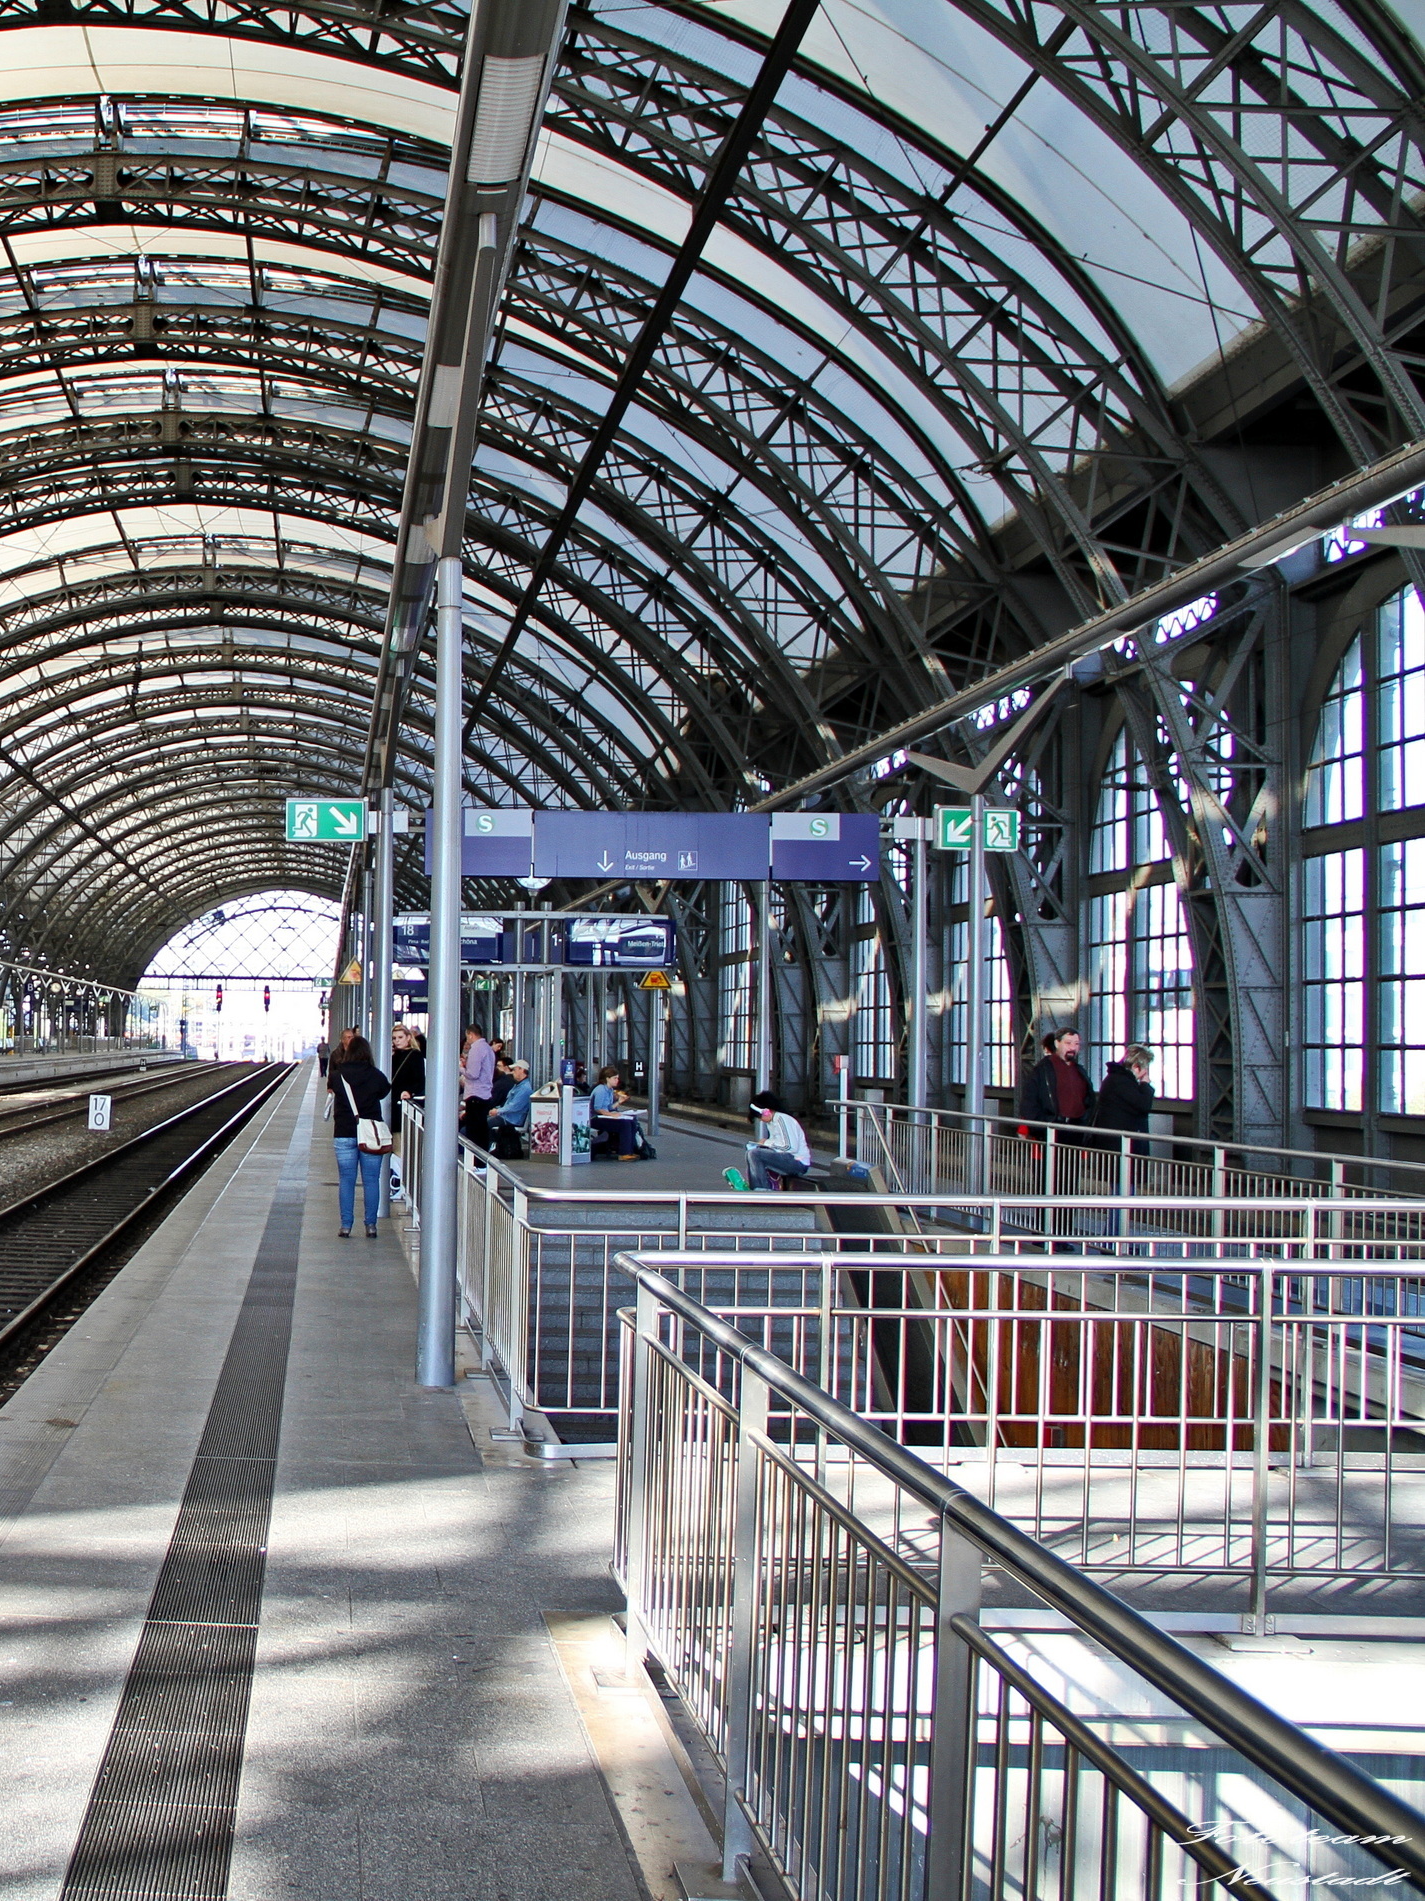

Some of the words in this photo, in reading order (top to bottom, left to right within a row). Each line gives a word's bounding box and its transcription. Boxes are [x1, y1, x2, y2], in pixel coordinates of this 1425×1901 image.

[625, 850, 666, 862] Ausgang
[401, 925, 414, 936] 18
[27, 983, 34, 992] B
[635, 1061, 643, 1071] H
[93, 1097, 107, 1111] 17
[94, 1112, 105, 1126] 0
